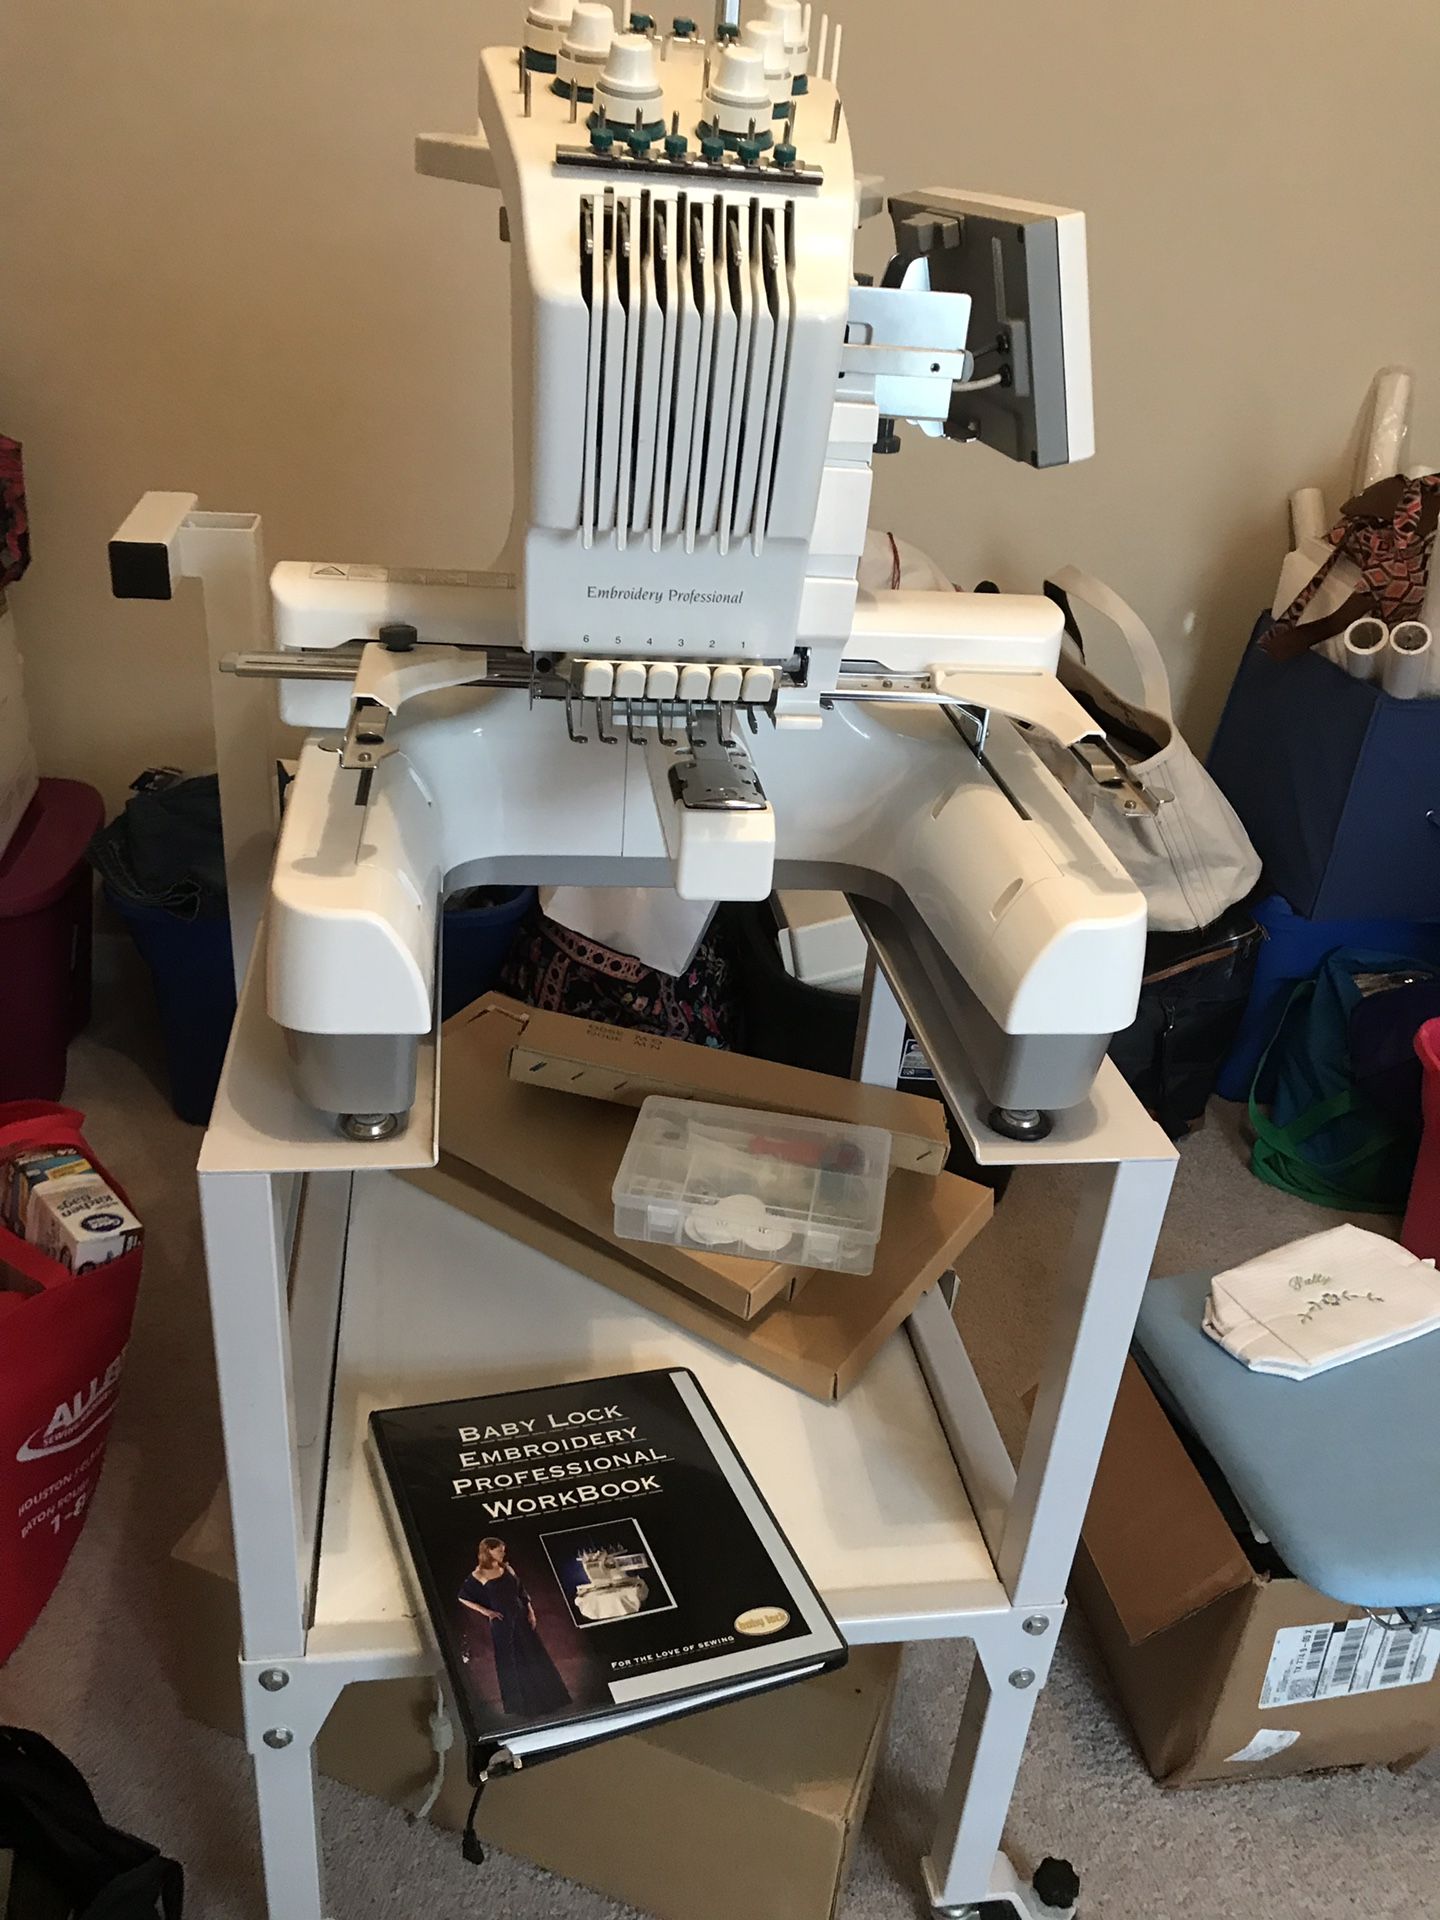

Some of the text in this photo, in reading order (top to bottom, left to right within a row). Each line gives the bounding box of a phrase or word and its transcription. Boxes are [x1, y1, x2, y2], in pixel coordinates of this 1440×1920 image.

[587, 586, 743, 605] Embroidery Professional
[583, 635, 590, 643] 6
[615, 636, 621, 644] 5
[647, 637, 653, 645] 4
[678, 639, 684, 647] 3
[709, 640, 715, 648] 2
[458, 1405, 624, 1442] BABY LOCK
[459, 1426, 638, 1468] EMBROIDERY
[452, 1447, 667, 1495] PROFESSIONAL
[18, 1474, 72, 1517] HOUSTON
[611, 1635, 735, 1669] FOR THE LOVE OF SEWING
